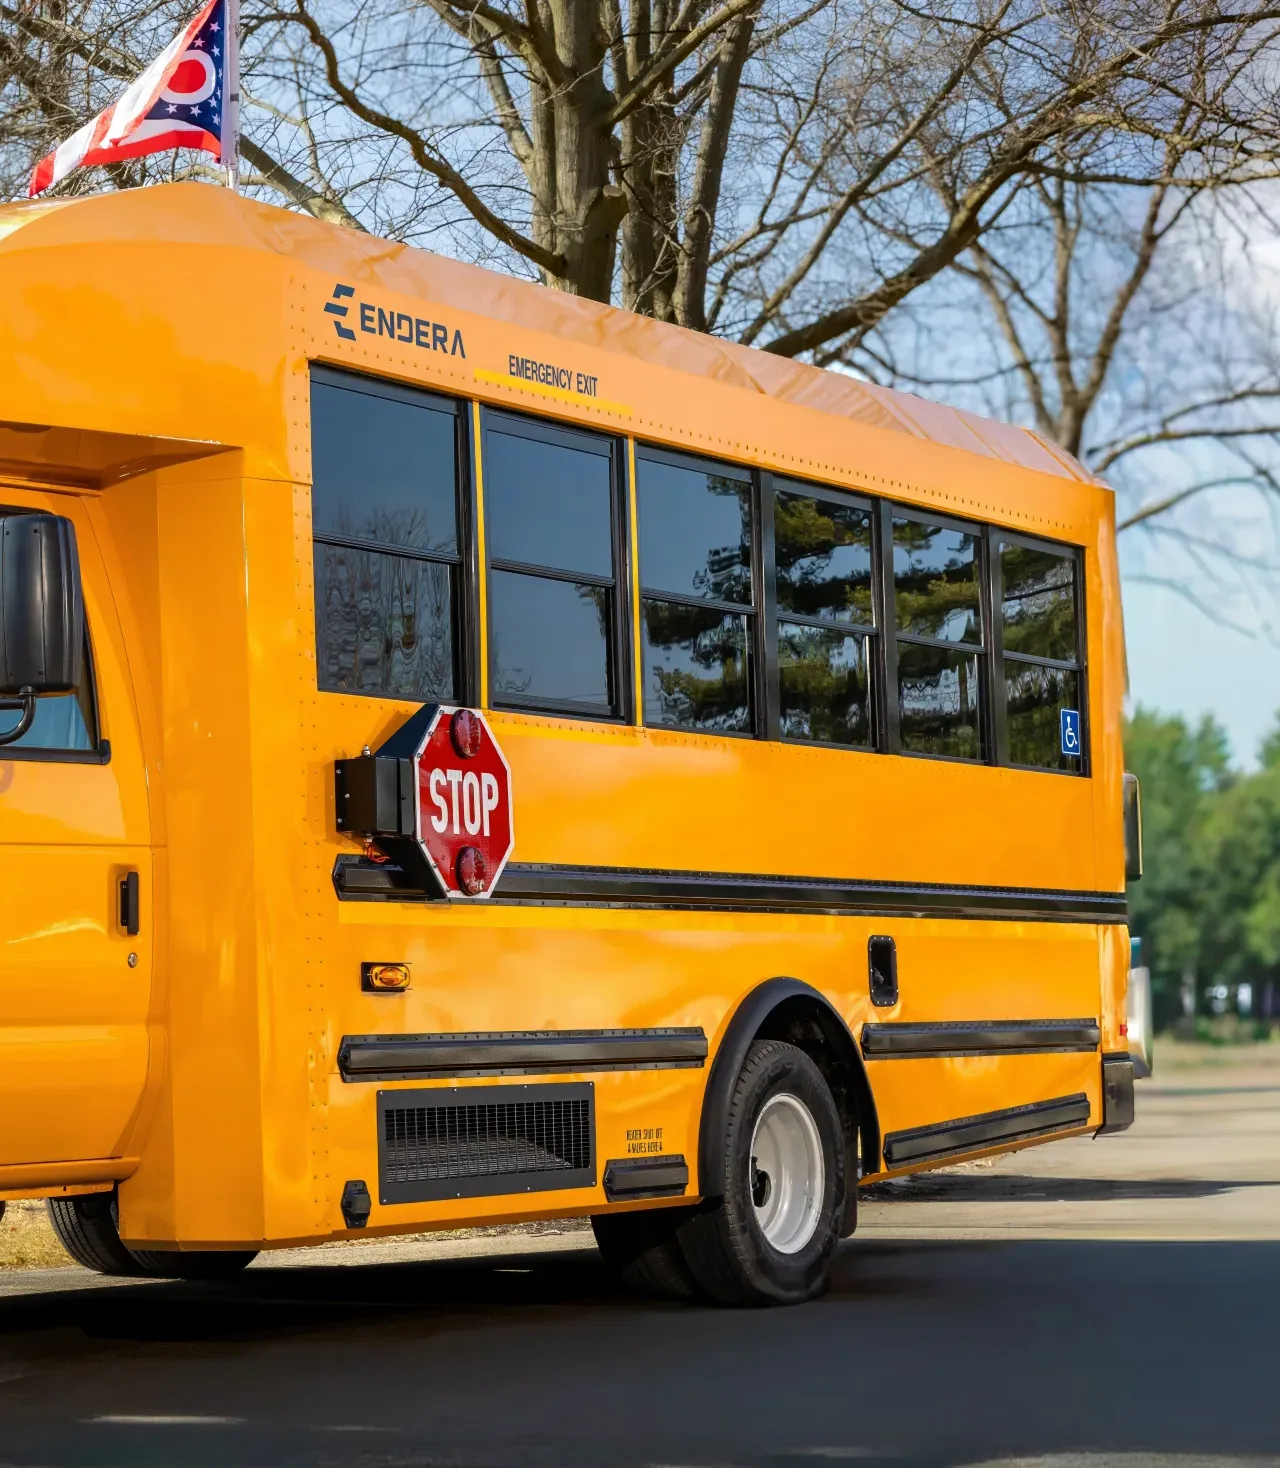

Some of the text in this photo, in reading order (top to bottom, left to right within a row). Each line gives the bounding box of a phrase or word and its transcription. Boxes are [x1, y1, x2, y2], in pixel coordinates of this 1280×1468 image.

[360, 302, 466, 358] ENDERA
[508, 354, 598, 397] EMERGENCY EXIT
[429, 768, 499, 837] STOP
